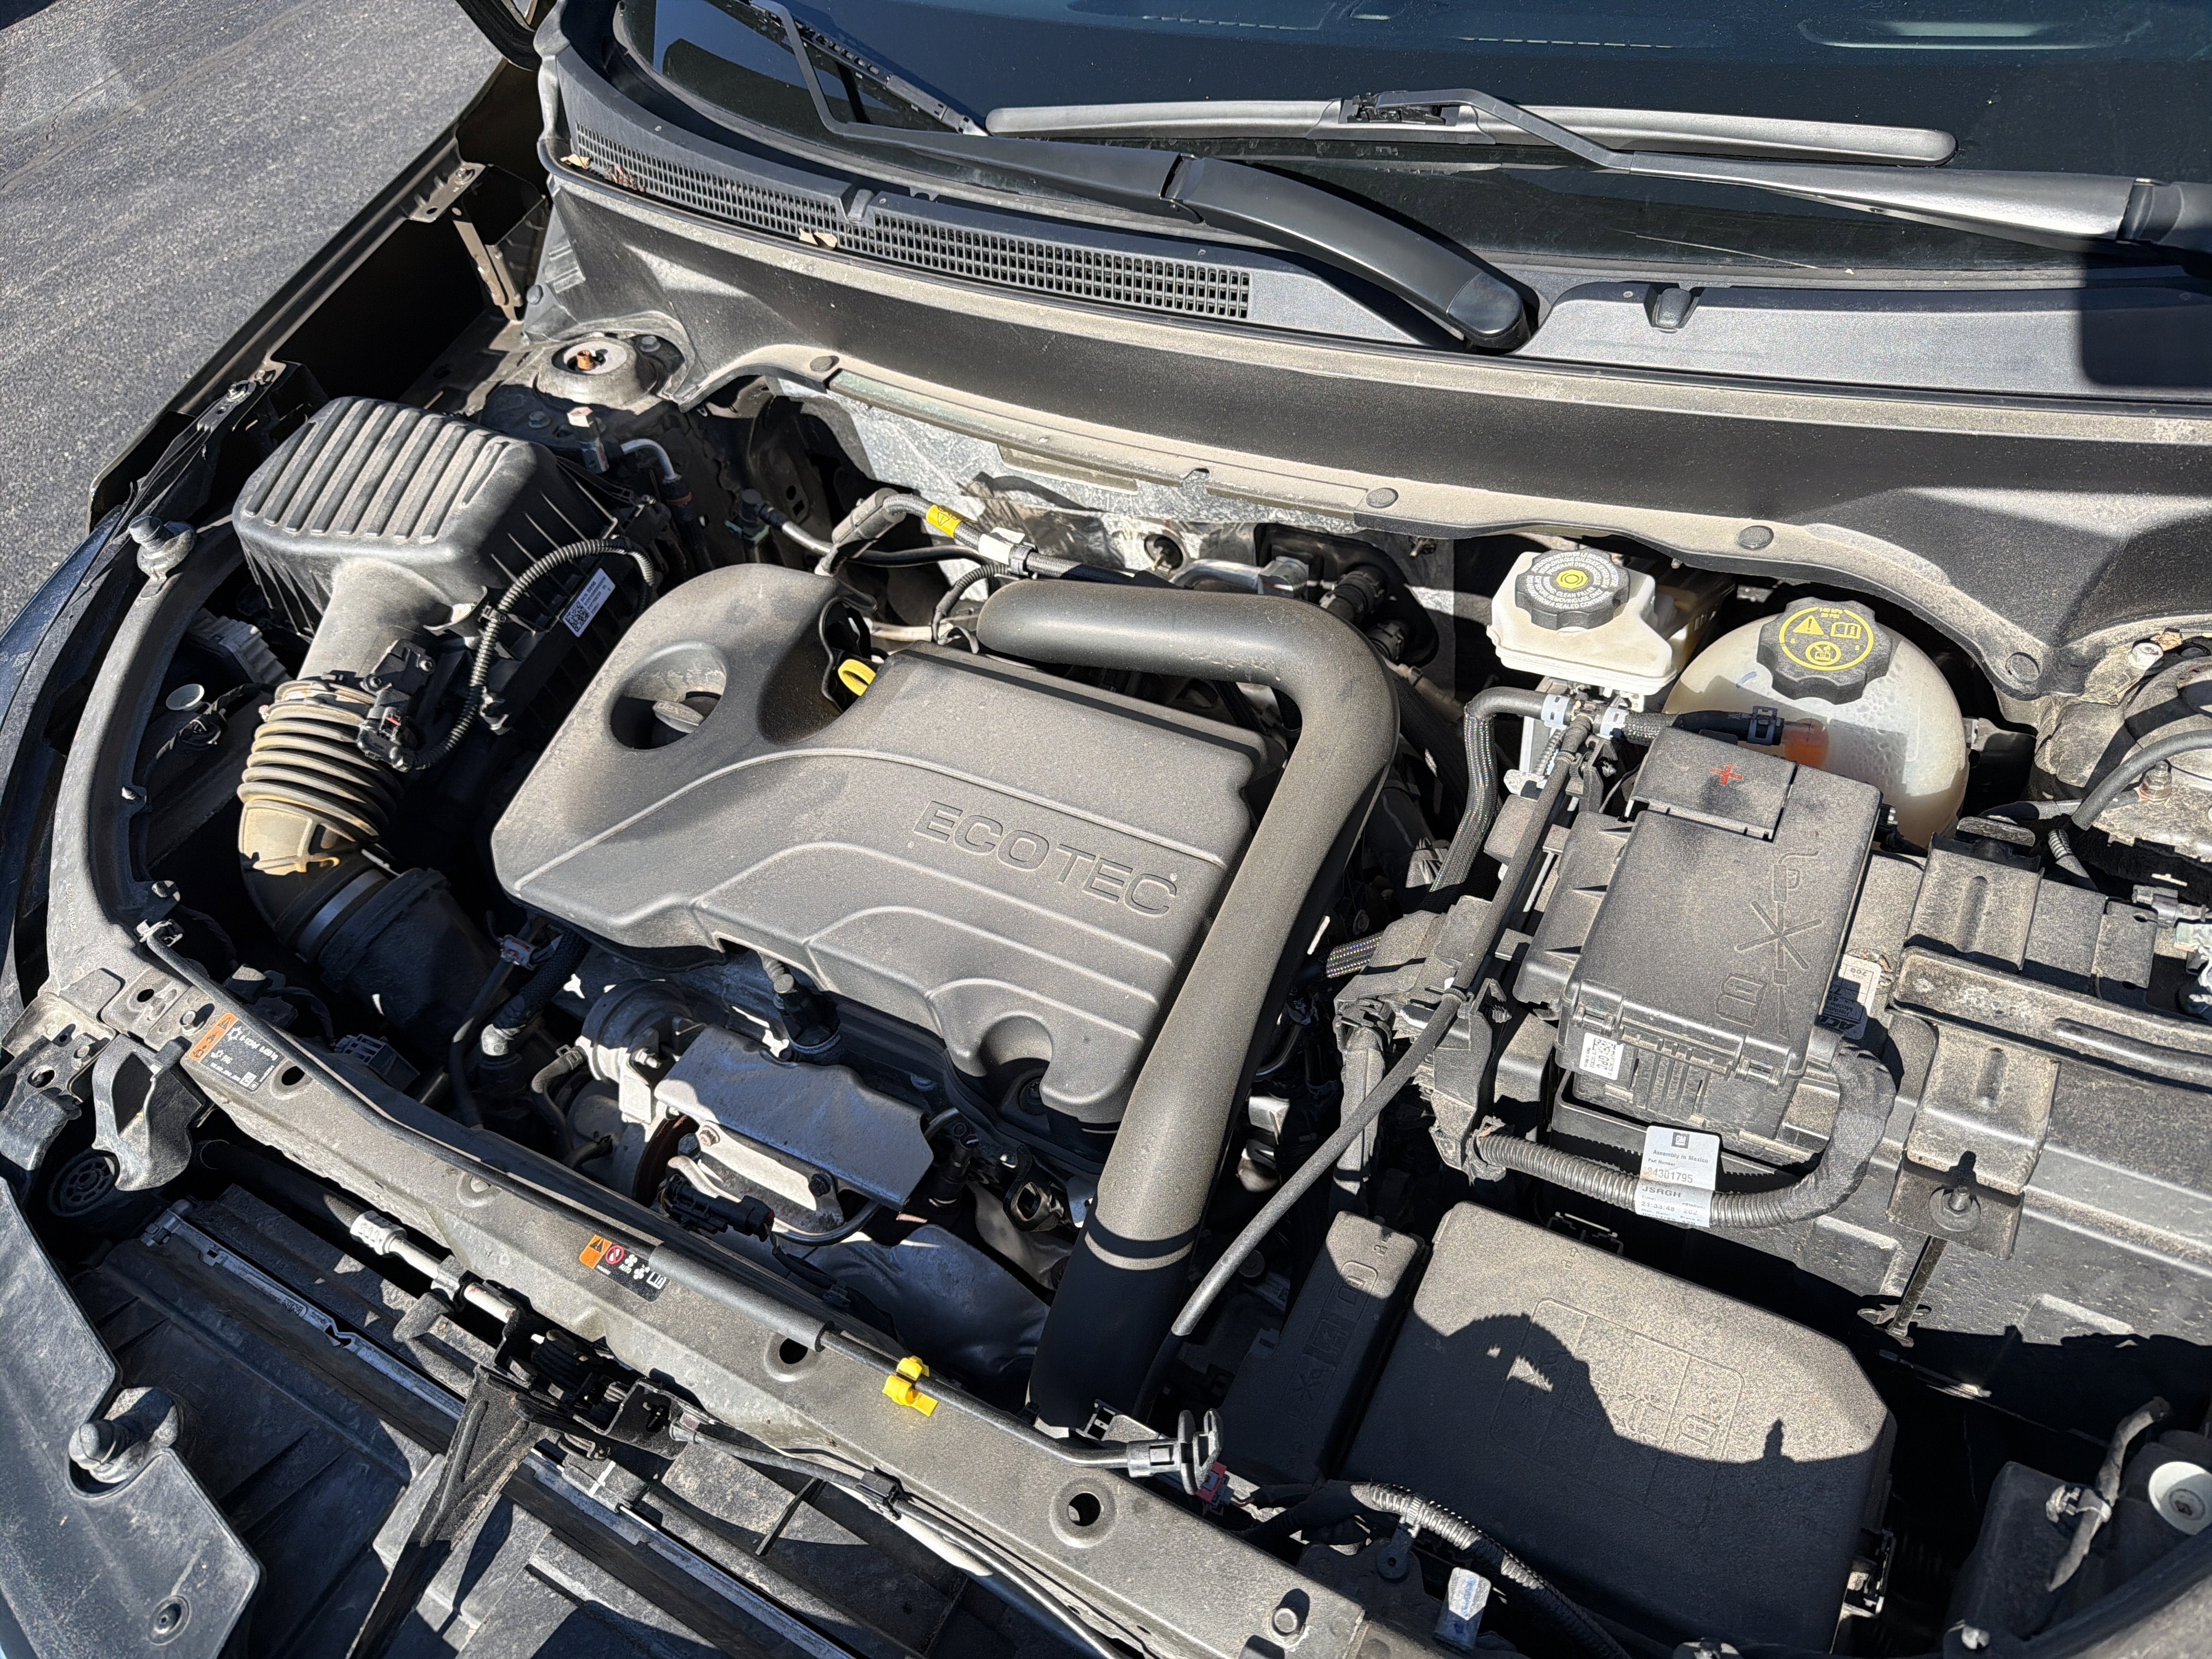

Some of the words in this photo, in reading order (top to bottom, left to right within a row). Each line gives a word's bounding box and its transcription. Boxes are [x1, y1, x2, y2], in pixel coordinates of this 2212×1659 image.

[1577, 586, 1596, 596] FILLER
[913, 800, 1178, 917] ECOTEC
[1850, 967, 1869, 977] 700
[1652, 1149, 1679, 1158] Assembly
[1688, 1155, 1708, 1164] Mexico
[1642, 1186, 1681, 1198] JSRGH
[1641, 1201, 1675, 1212] 21:33:48
[1683, 1207, 1698, 1216] 202
[618, 1263, 633, 1274] AUTO
